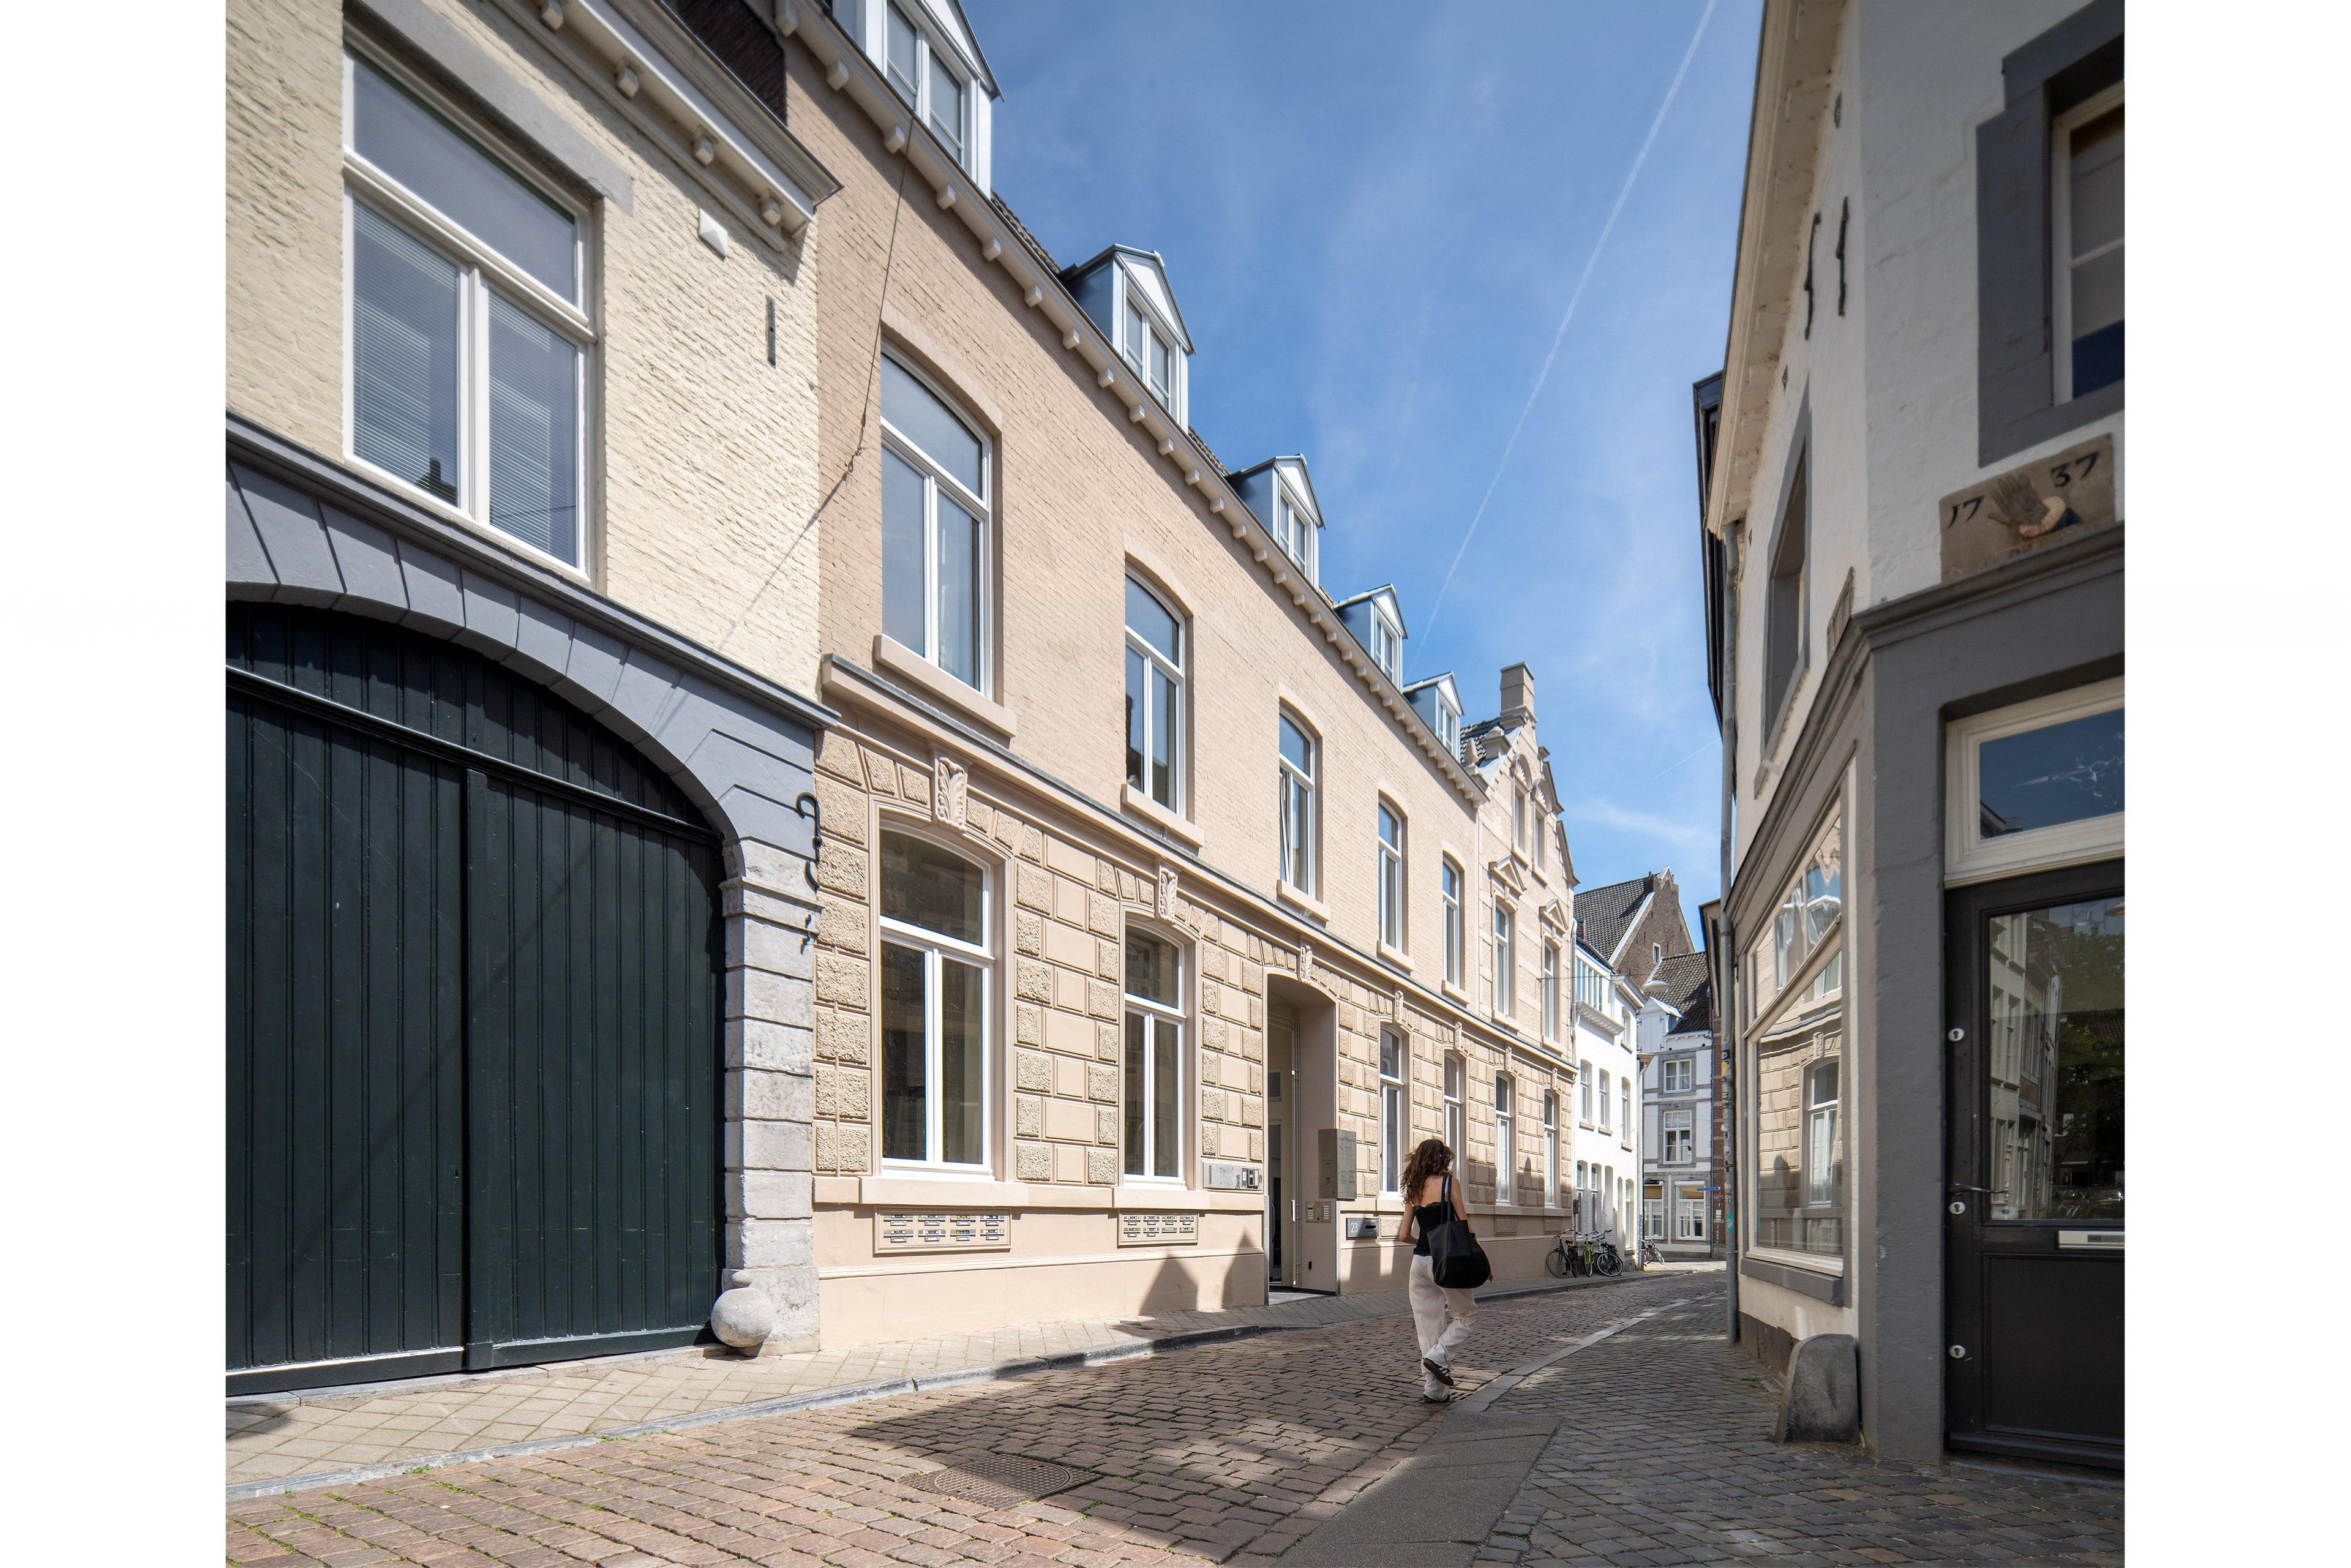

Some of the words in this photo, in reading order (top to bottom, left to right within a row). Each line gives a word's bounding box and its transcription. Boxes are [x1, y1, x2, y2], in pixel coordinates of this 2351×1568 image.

[1948, 495, 1985, 530] 17
[2051, 451, 2099, 487] 37
[1351, 1222, 1358, 1233] 23
